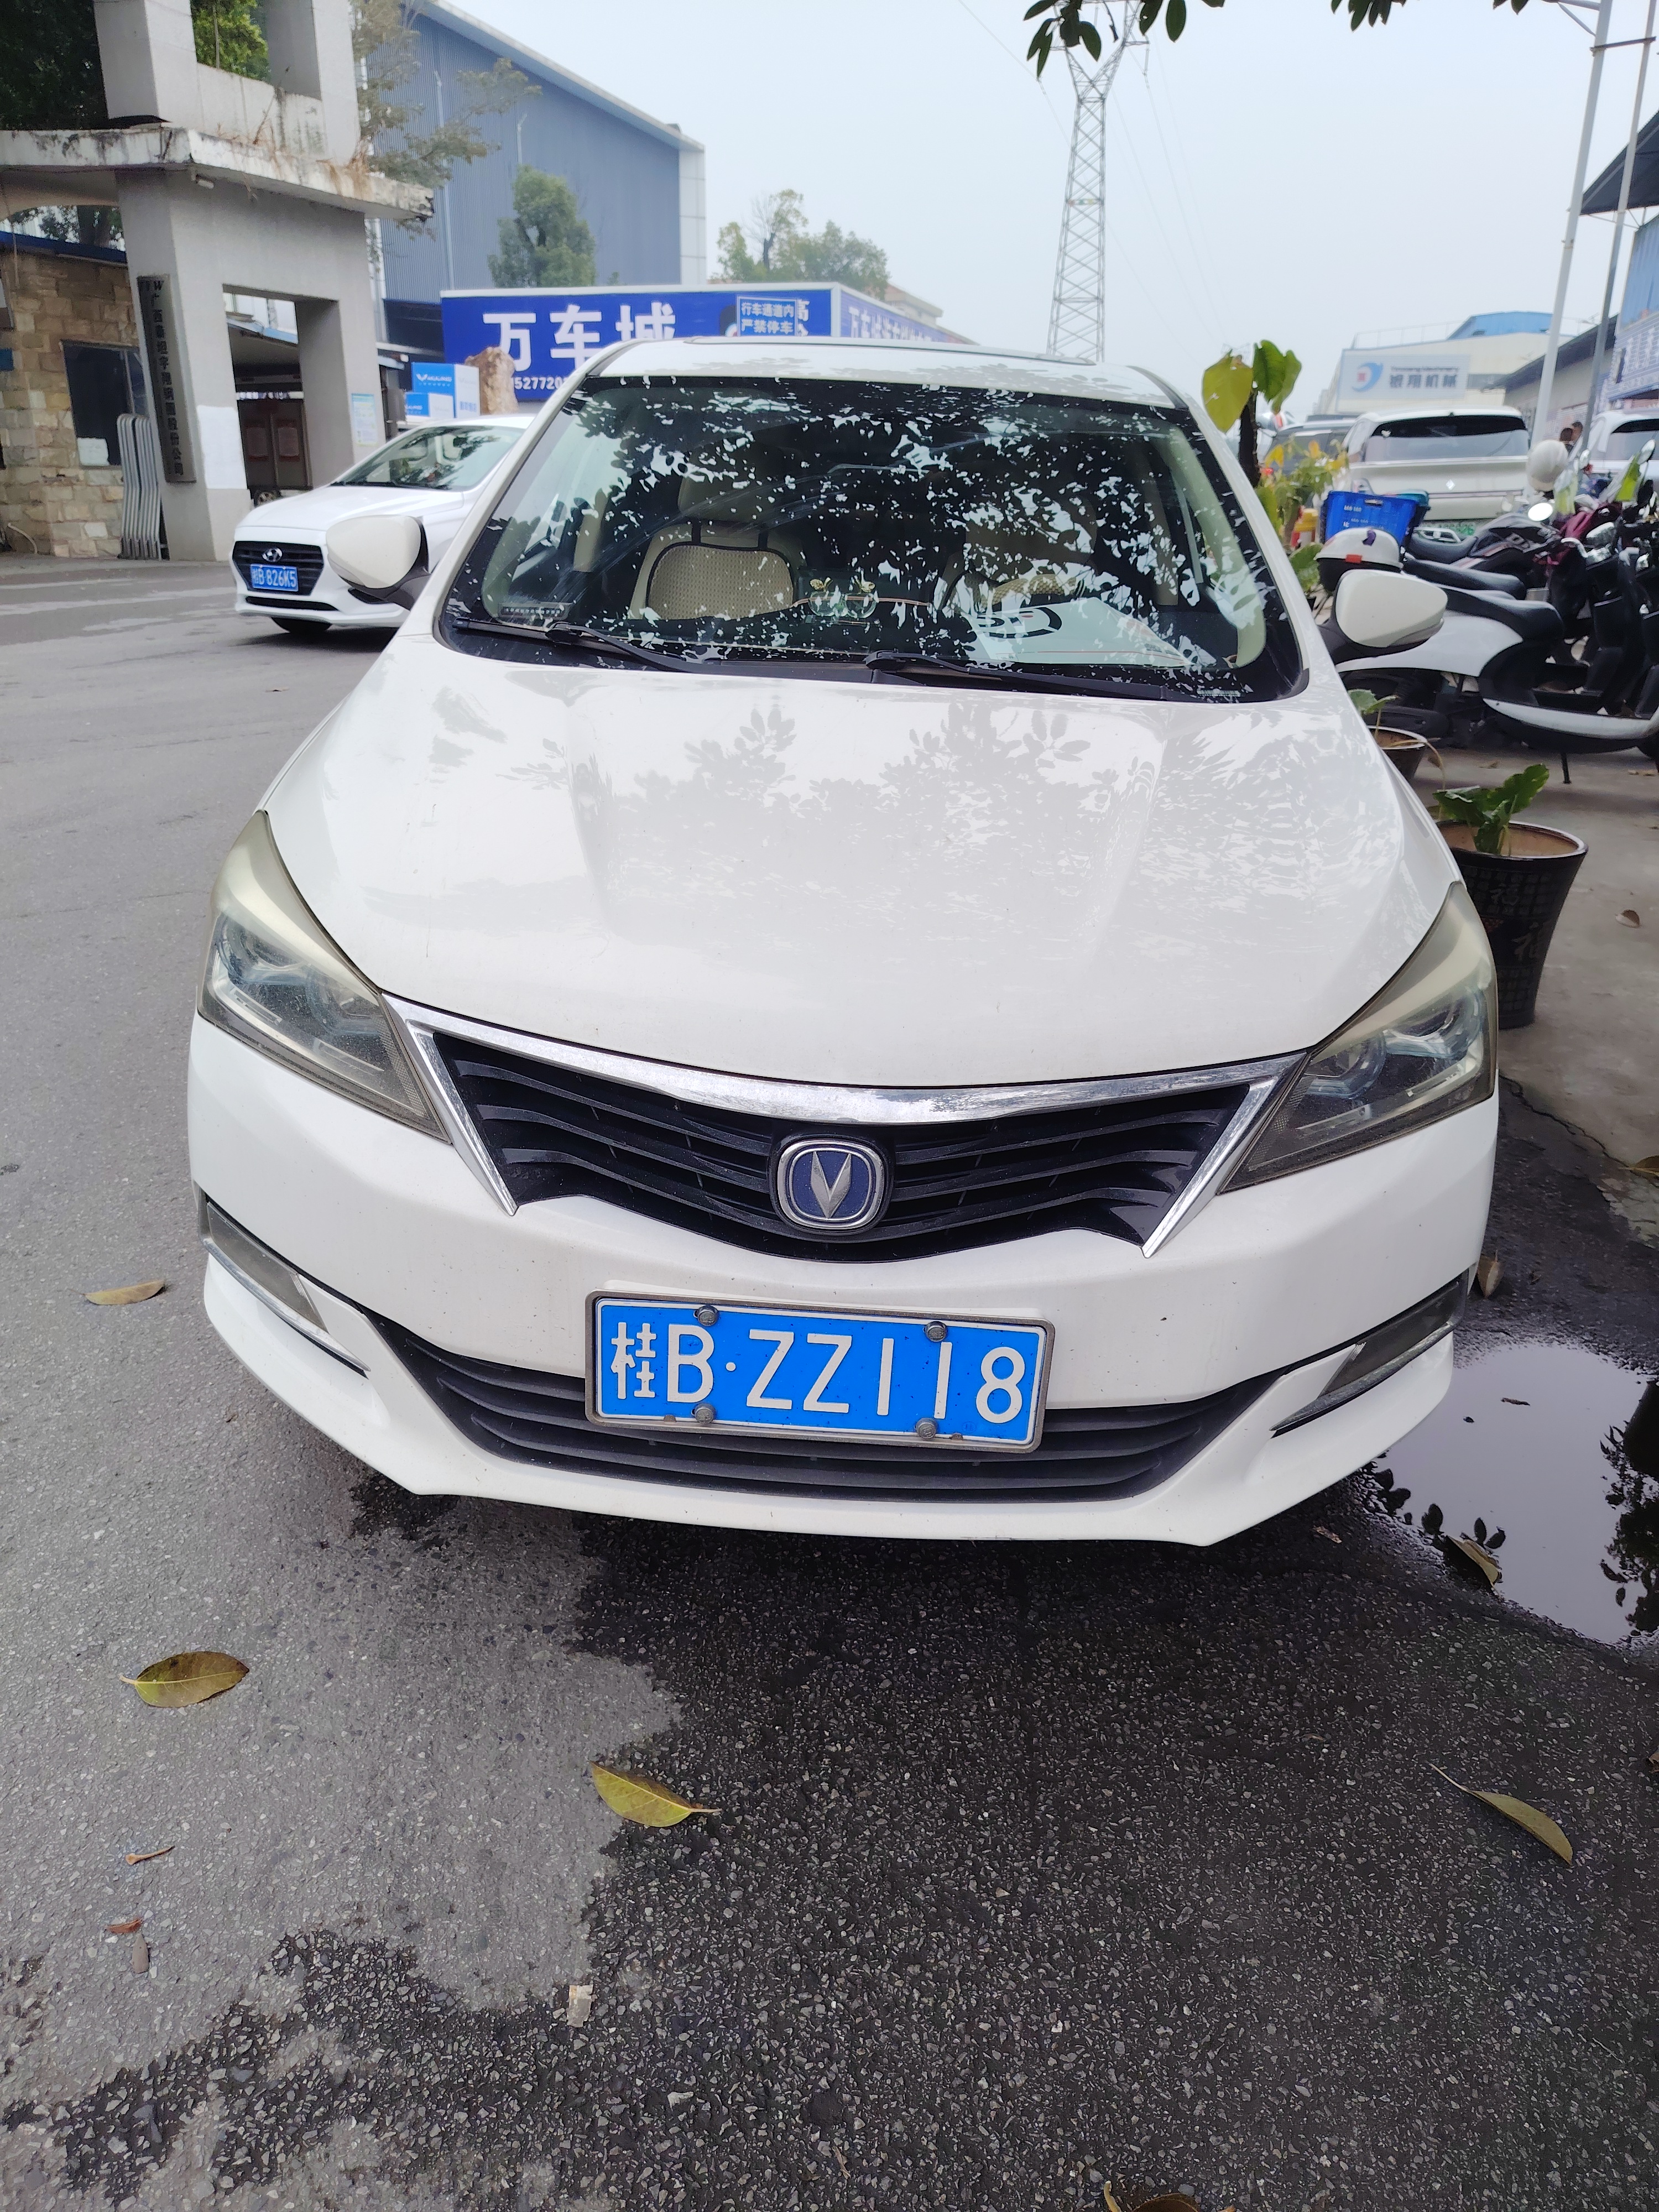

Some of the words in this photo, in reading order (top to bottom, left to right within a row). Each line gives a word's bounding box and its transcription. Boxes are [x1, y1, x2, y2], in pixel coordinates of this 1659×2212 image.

[741, 302, 794, 318] 行车通道内
[741, 319, 794, 335] 严禁停车
[482, 301, 676, 372] 万车城
[510, 376, 570, 390] 527720
